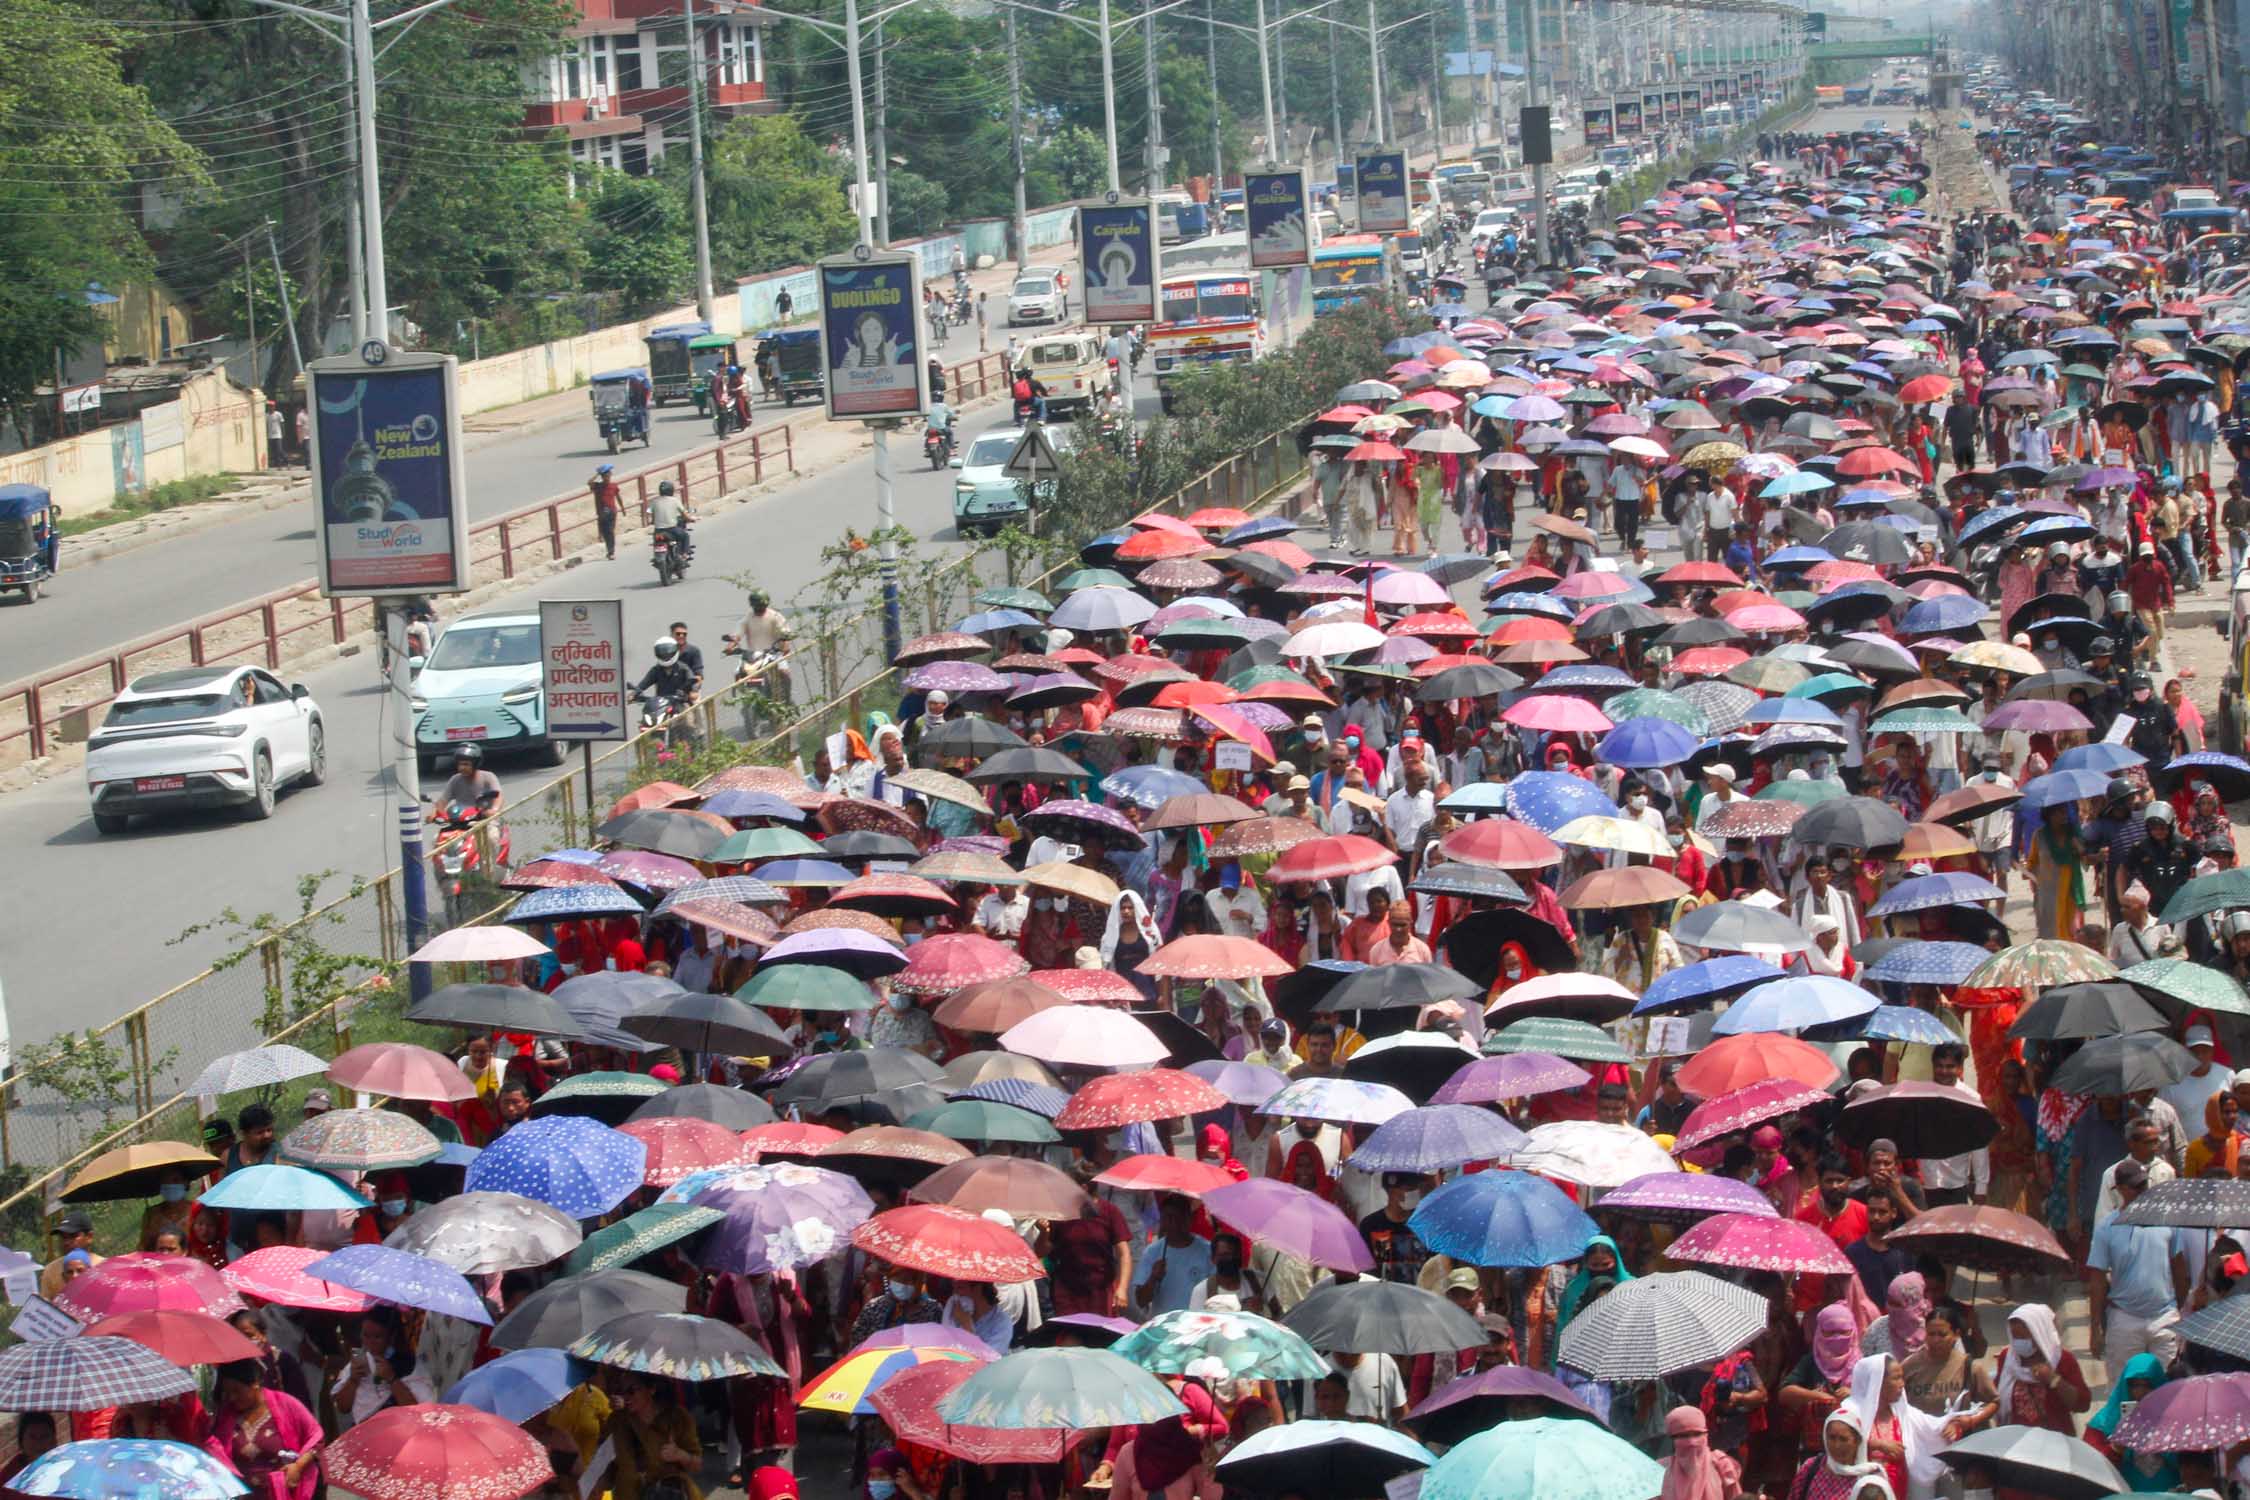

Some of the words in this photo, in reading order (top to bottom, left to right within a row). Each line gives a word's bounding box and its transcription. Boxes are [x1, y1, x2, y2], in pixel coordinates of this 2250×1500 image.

[831, 288, 901, 309] DUOLINGO
[365, 344, 383, 361] 49
[375, 429, 411, 443] New
[376, 442, 441, 460] Zealand
[382, 534, 422, 548] World
[551, 640, 613, 665] लुम्बिनी
[550, 664, 617, 685] प्रादेशिक
[548, 691, 620, 709] अस्पताल
